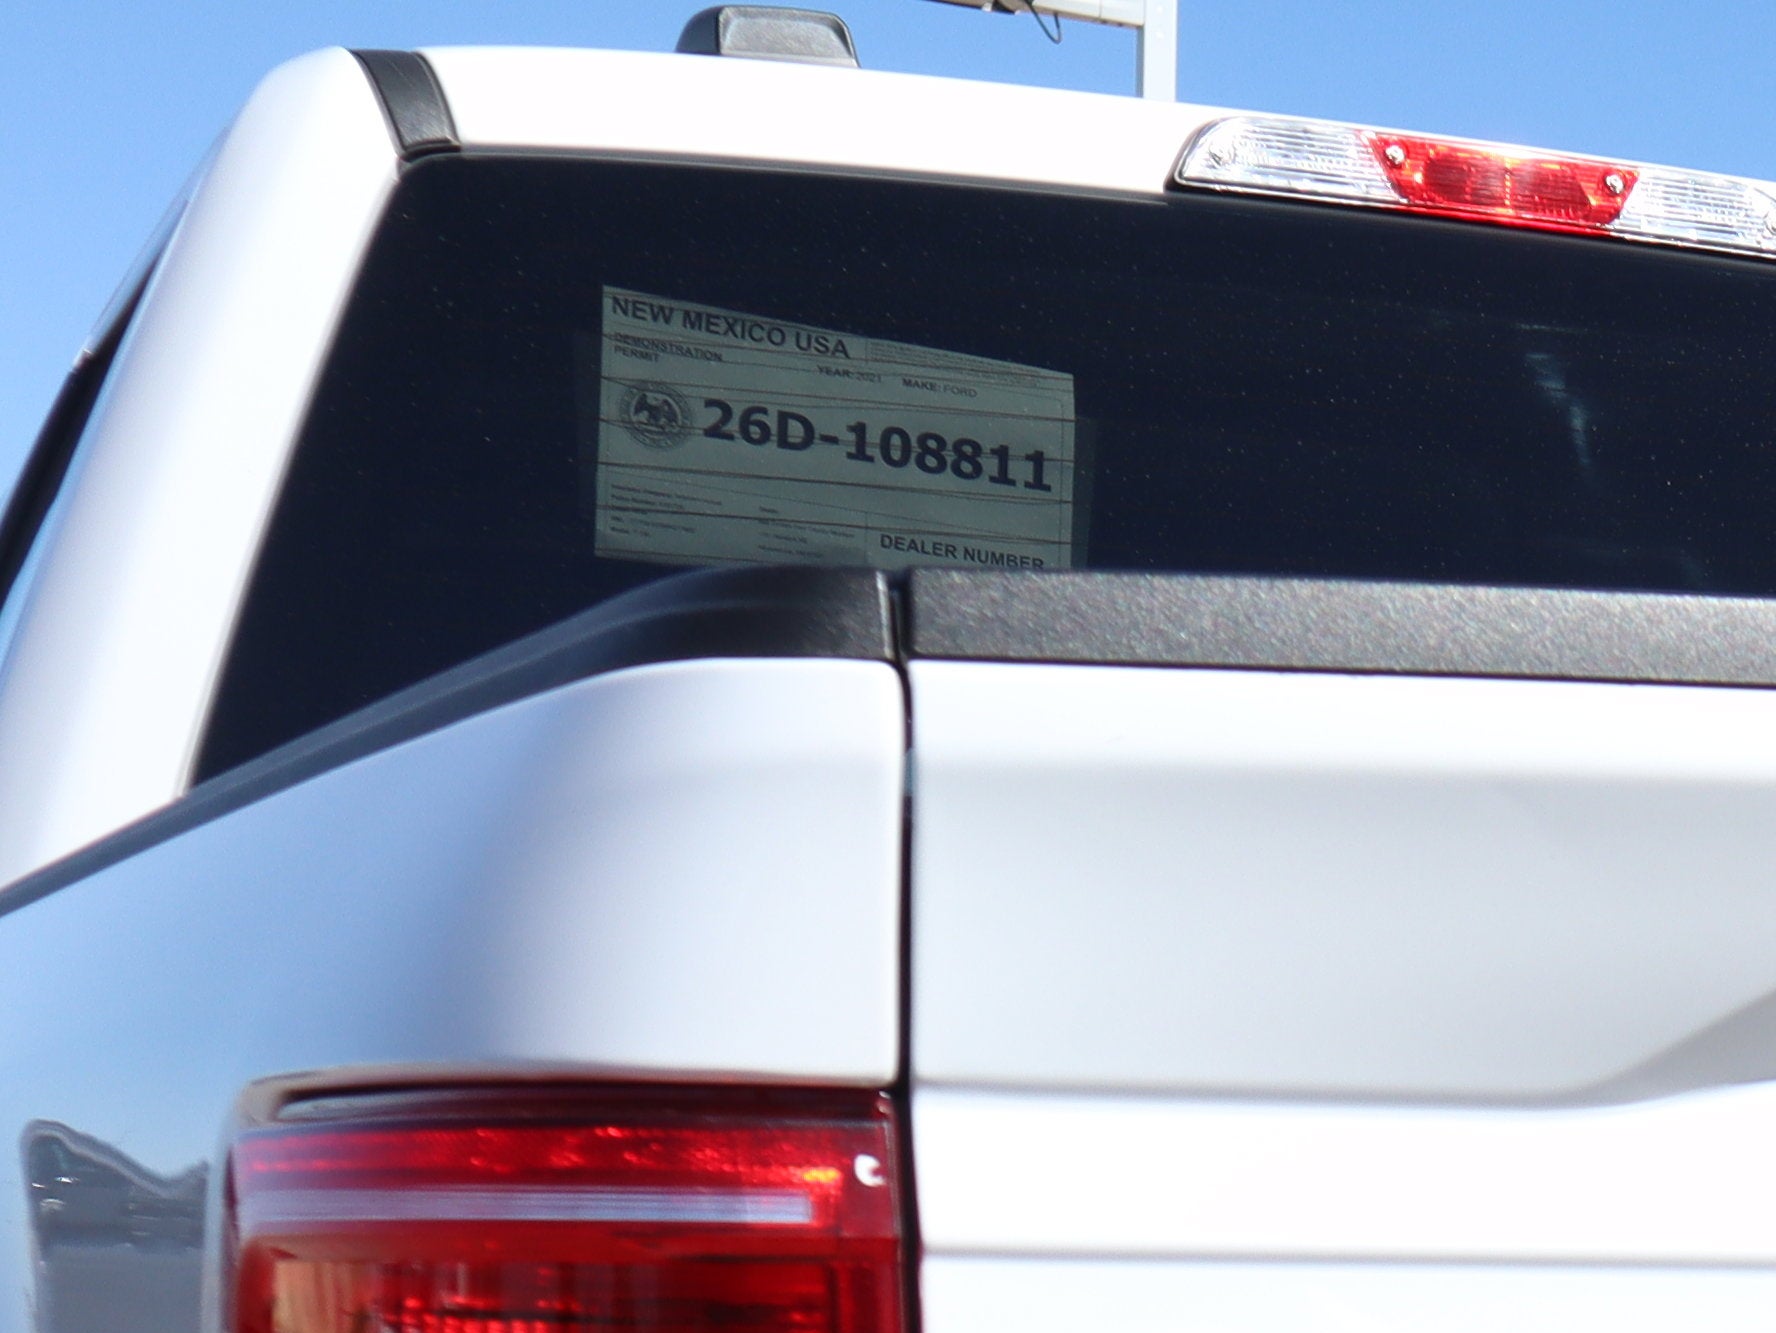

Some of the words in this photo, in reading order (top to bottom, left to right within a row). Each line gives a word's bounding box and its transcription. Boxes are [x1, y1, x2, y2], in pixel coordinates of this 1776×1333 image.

[611, 295, 675, 325] NEW
[682, 309, 786, 347] MEXICO
[795, 330, 851, 359] USA
[613, 331, 723, 362] DEMONSTRATION
[613, 345, 661, 363] PERMIT
[943, 383, 978, 398] FORD
[703, 398, 1052, 493] 26D-108811
[880, 533, 958, 560] DEALER
[963, 546, 1045, 570] NUMBER
